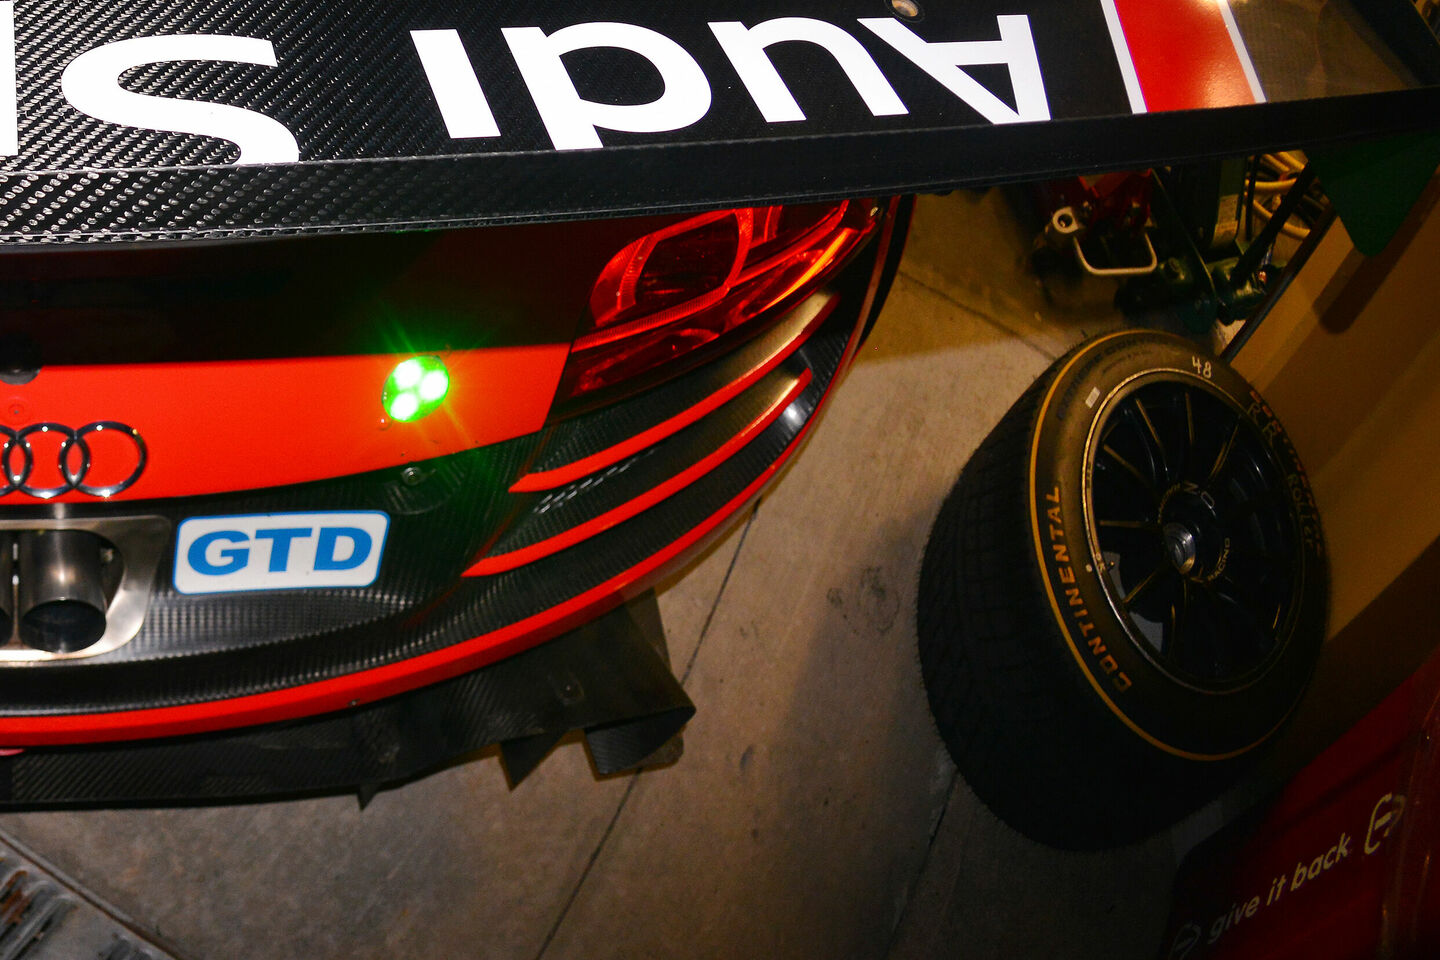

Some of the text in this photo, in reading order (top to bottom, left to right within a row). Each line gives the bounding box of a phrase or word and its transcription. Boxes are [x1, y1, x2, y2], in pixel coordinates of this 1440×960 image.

[410, 15, 1050, 150] Audi
[1191, 354, 1214, 380] 48
[186, 526, 373, 576] GTD
[1045, 486, 1133, 693] CONTINENTAL
[1206, 831, 1353, 946] give it back
